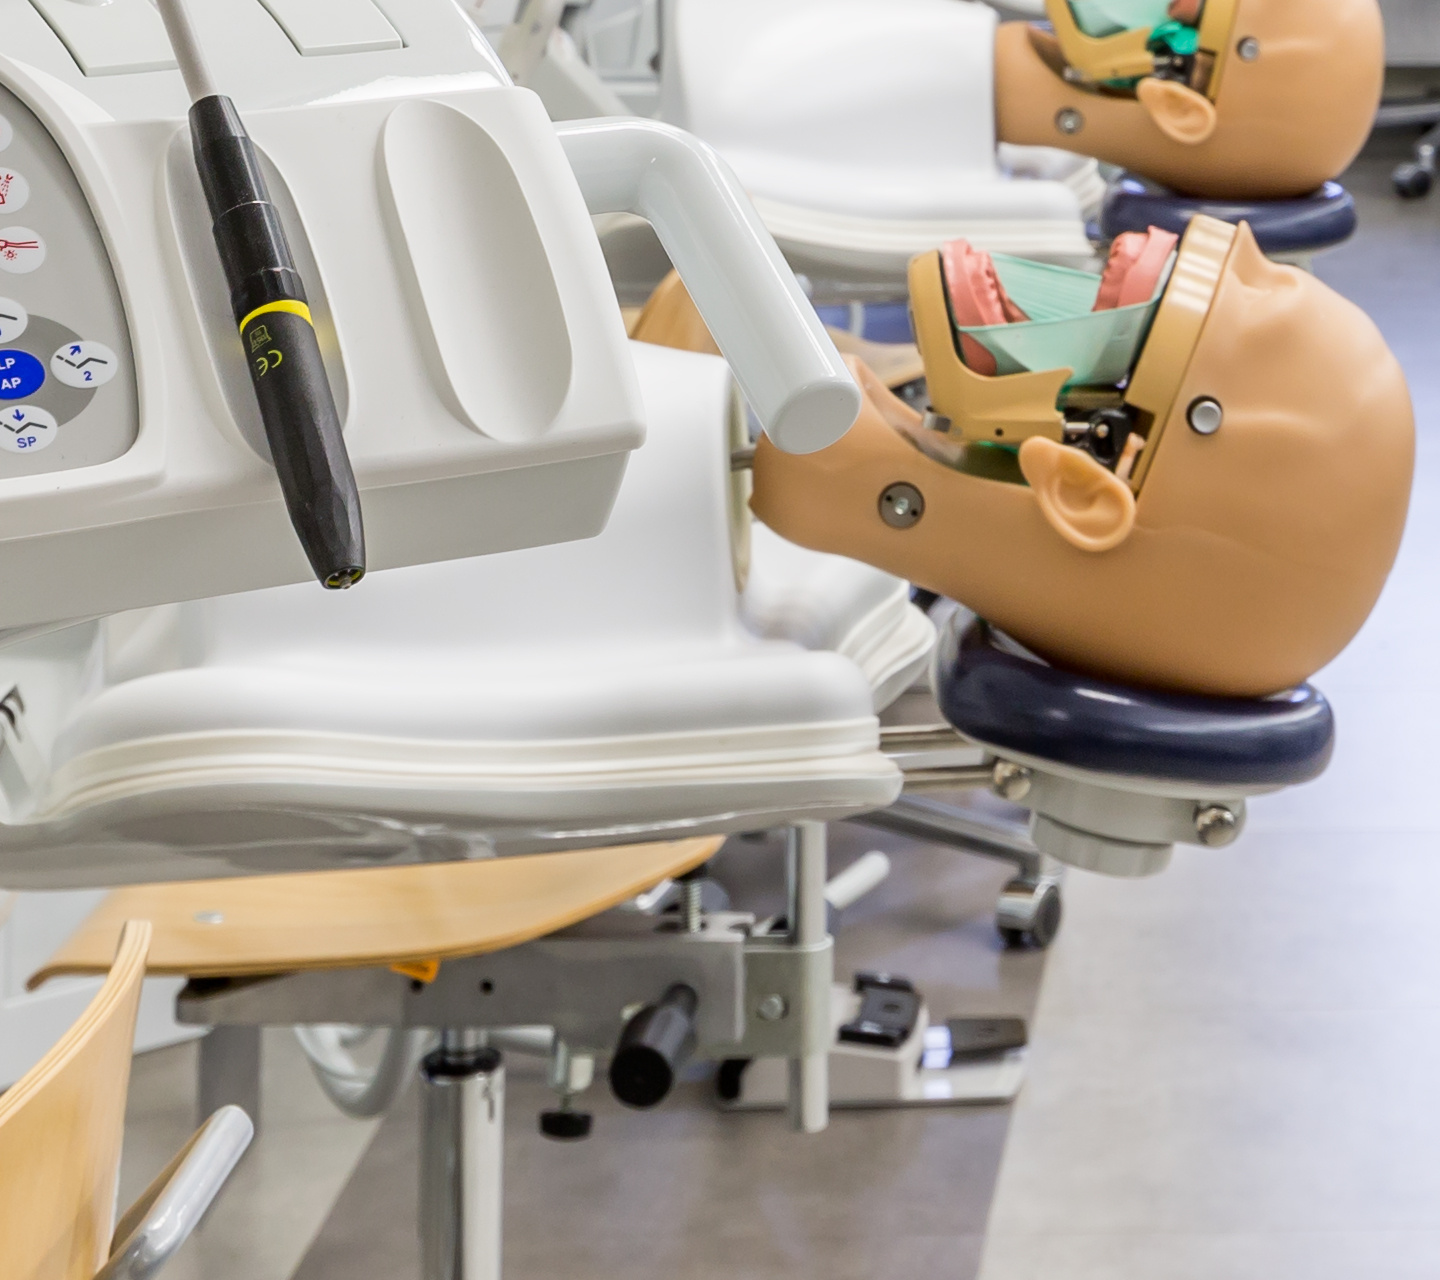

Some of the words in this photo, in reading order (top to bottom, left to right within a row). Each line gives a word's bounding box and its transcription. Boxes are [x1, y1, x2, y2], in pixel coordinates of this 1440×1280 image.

[256, 349, 283, 377] CE
[83, 370, 93, 381] 2
[0, 376, 23, 390] AP
[16, 436, 37, 449] SP
